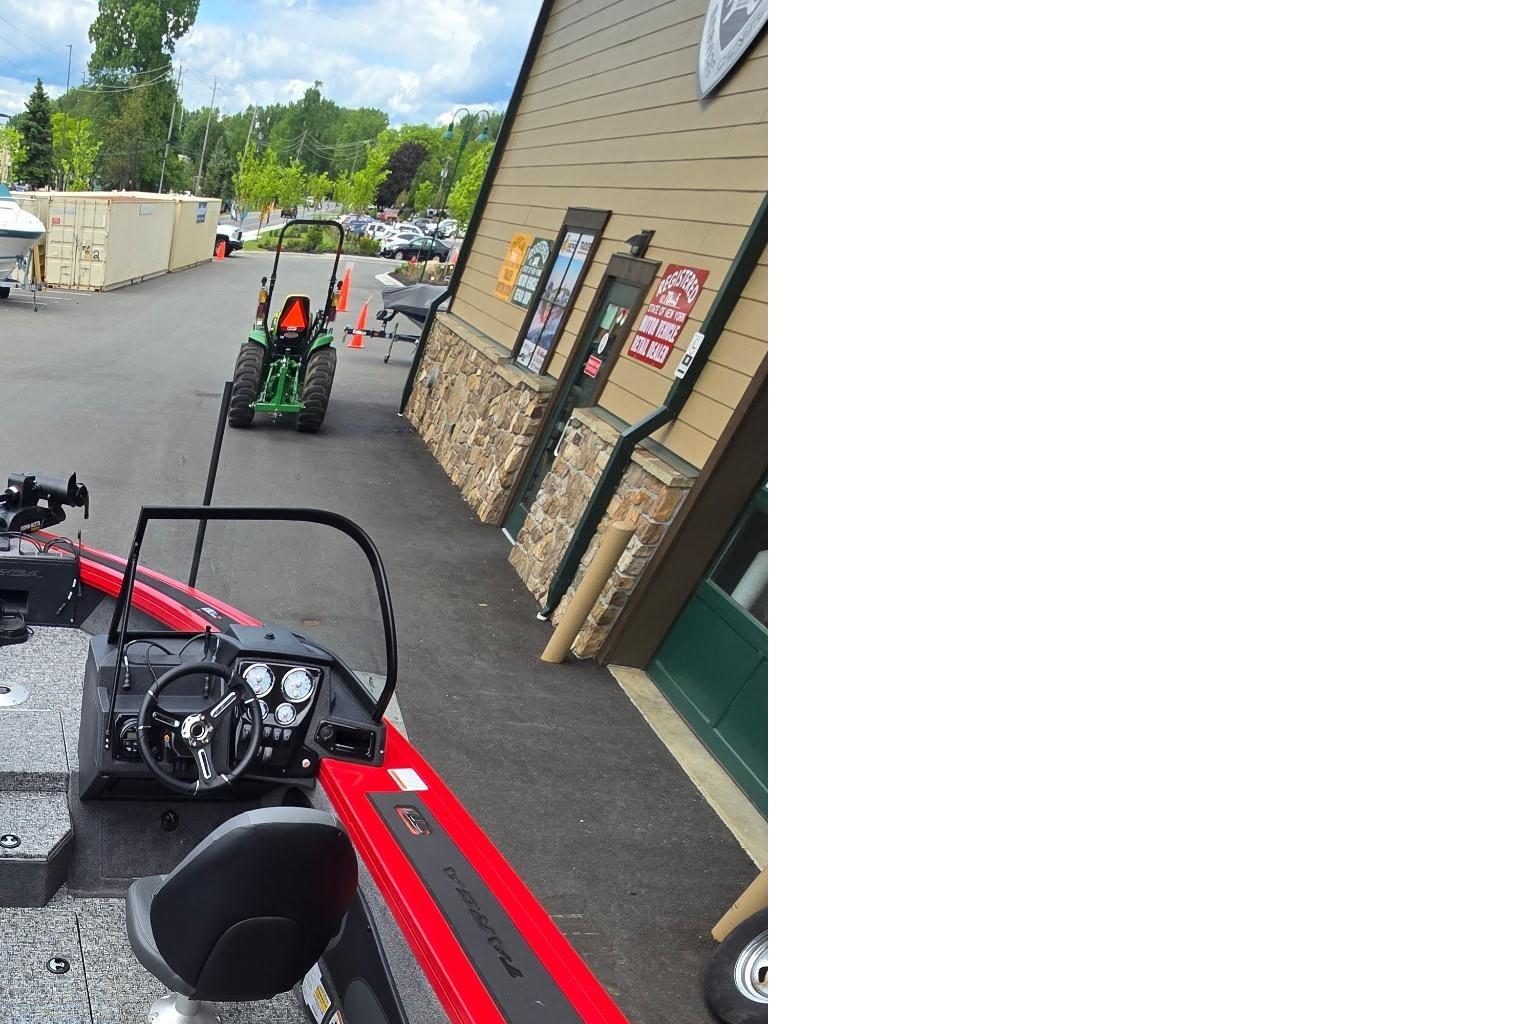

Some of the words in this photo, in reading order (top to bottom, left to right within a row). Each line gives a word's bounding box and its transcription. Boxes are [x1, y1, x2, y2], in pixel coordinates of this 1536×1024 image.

[656, 269, 699, 304] REGISTERED
[655, 319, 681, 343] VEHICLE
[645, 340, 670, 364] DEALER
